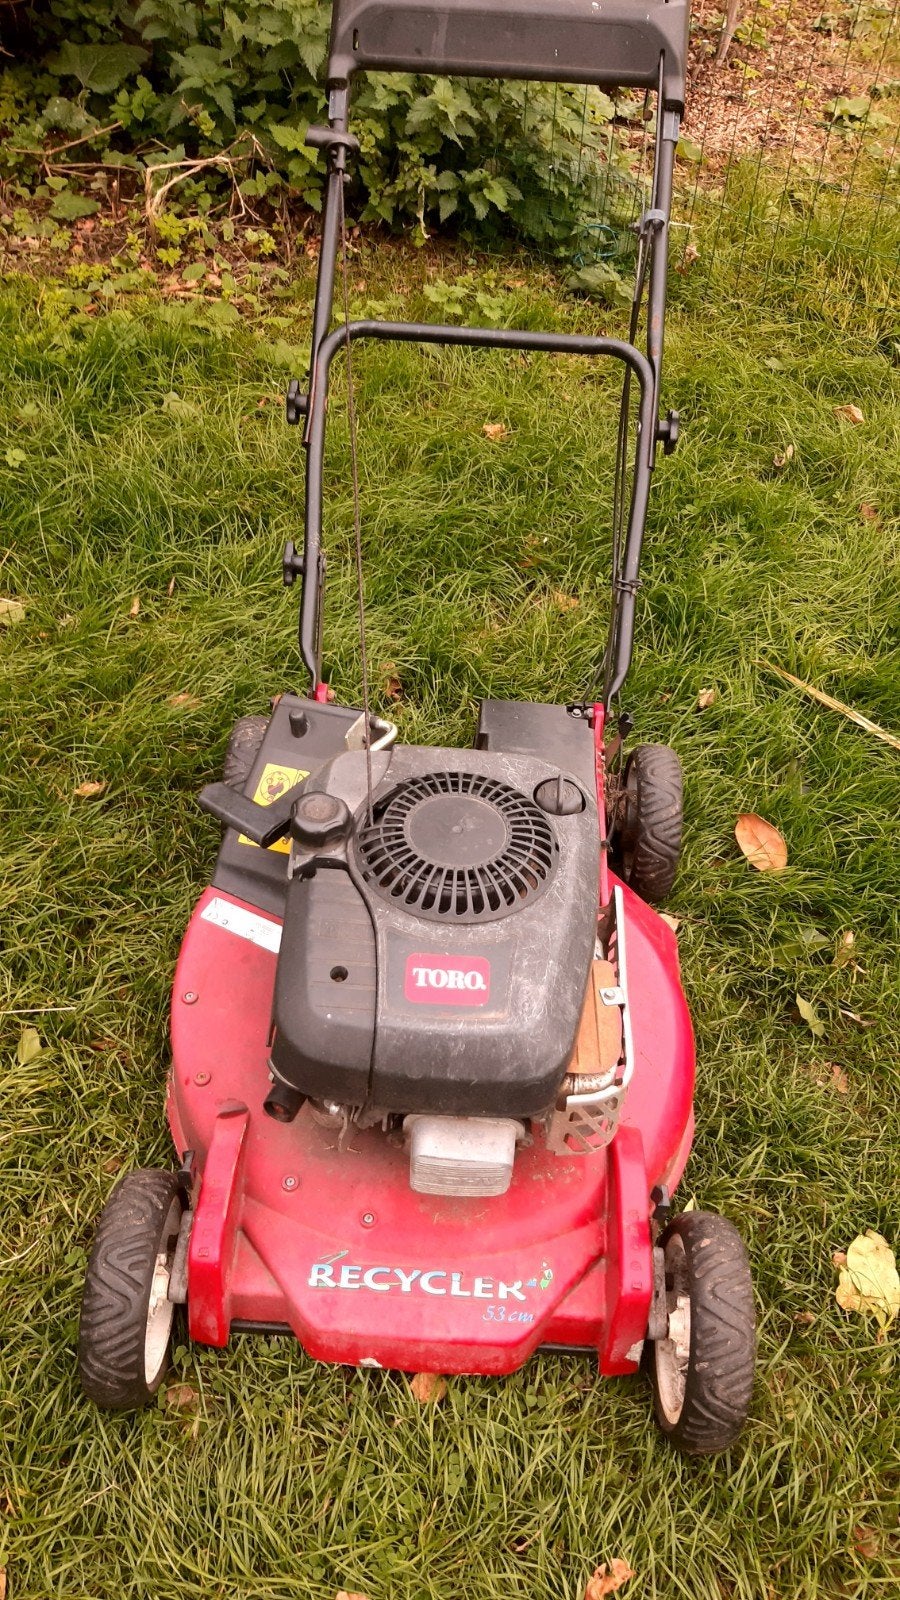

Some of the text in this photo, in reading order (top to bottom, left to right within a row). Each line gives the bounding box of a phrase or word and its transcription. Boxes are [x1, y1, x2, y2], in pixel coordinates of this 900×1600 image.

[412, 967, 485, 990] TORO
[308, 1263, 526, 1301] RECYCLER
[482, 1305, 534, 1323] 53 cm
